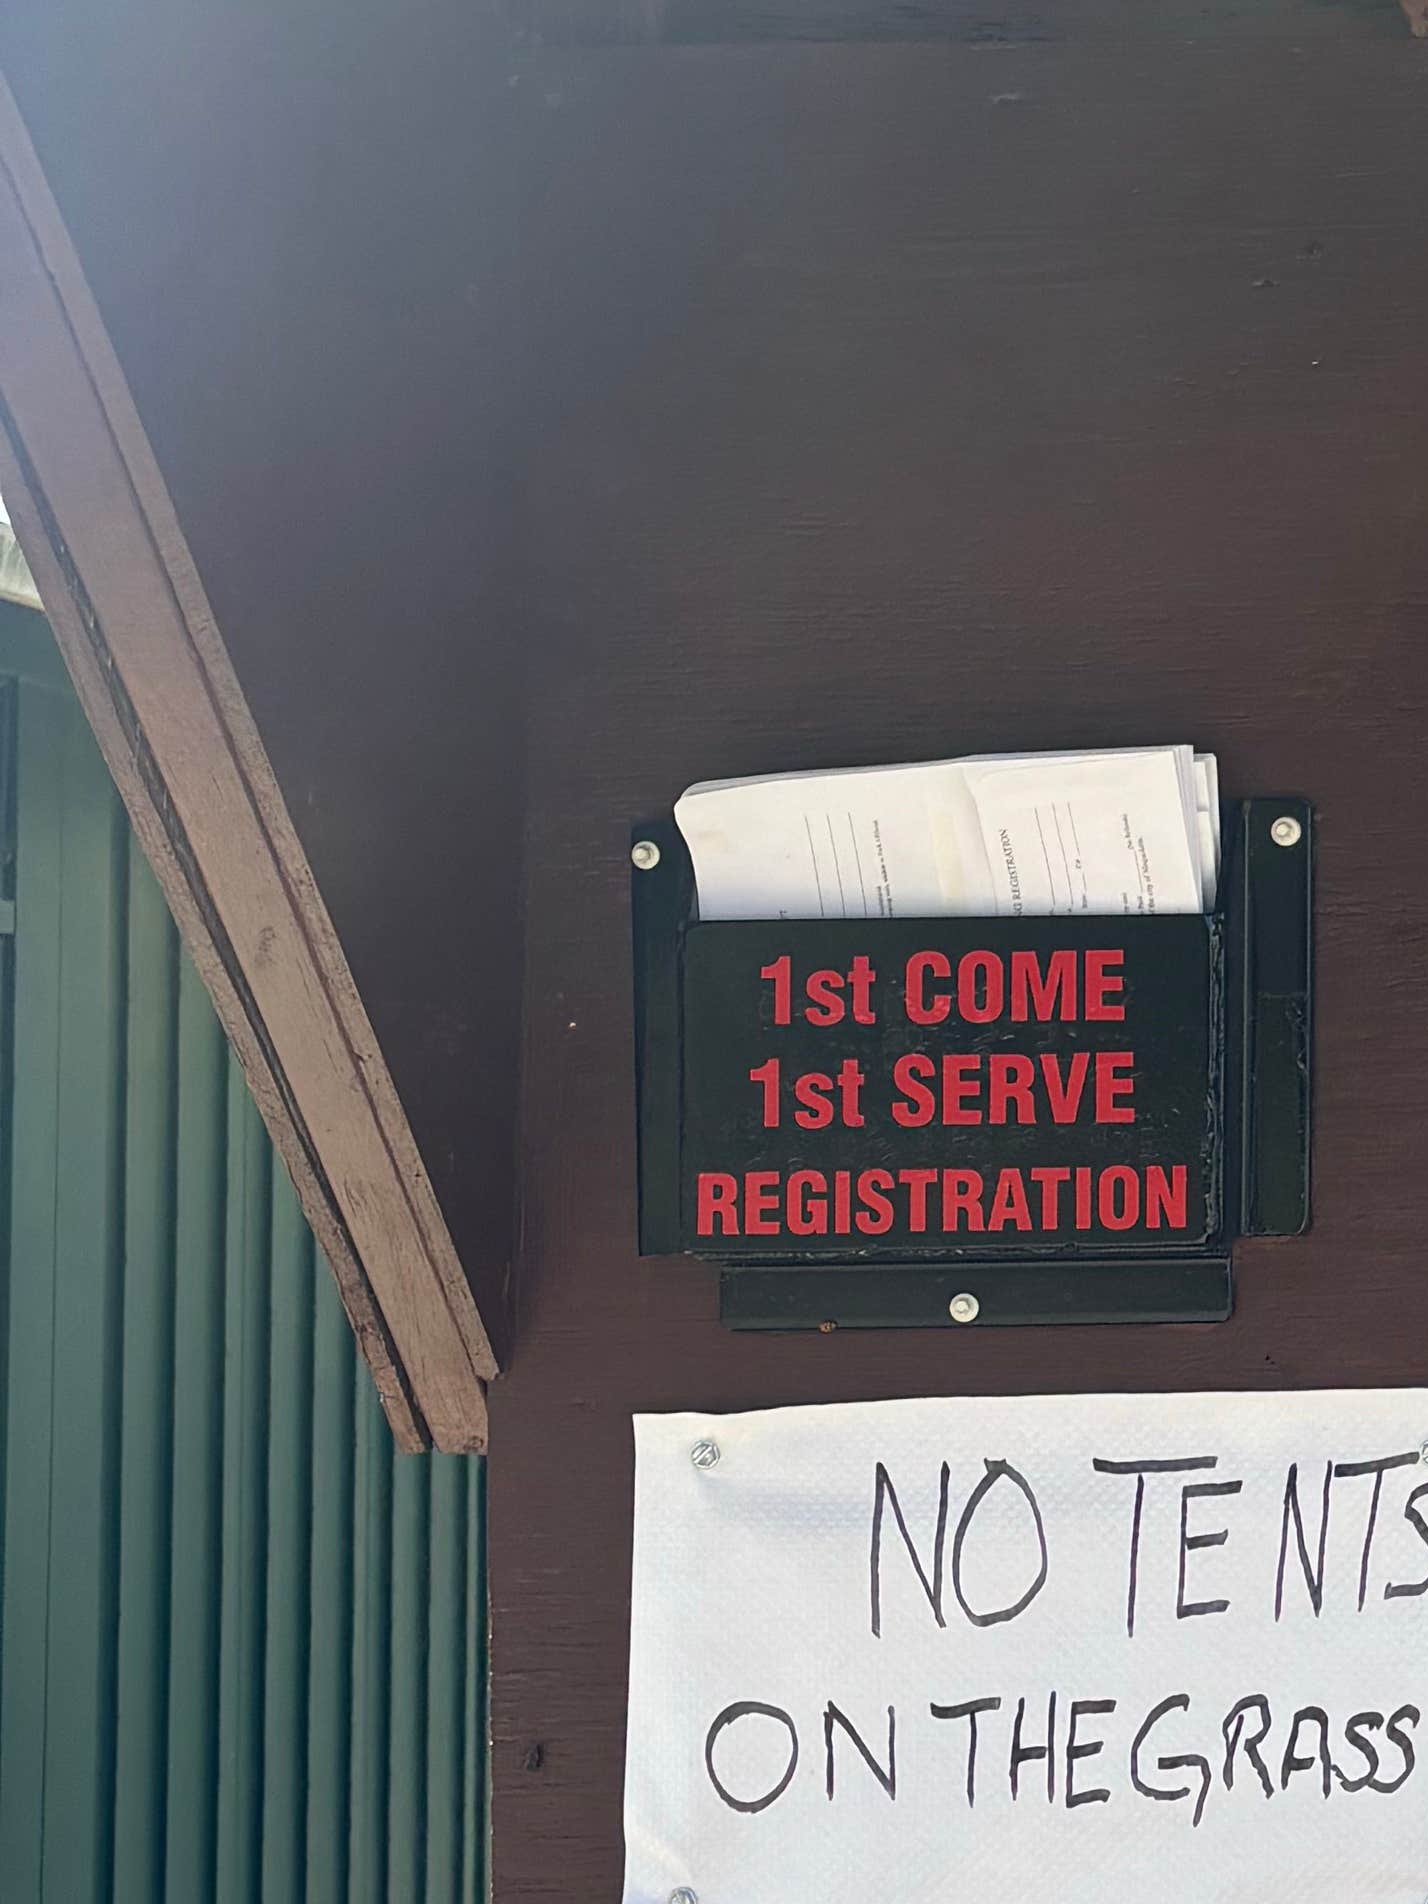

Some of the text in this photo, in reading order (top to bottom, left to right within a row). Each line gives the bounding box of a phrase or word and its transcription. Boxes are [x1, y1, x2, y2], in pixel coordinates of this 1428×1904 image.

[761, 950, 1124, 1025] 1st COME
[750, 1052, 1135, 1129] 1st SERVE
[698, 1165, 1186, 1235] REGISTRATION
[871, 1458, 1047, 1638] NO
[705, 1701, 895, 1813] ON
